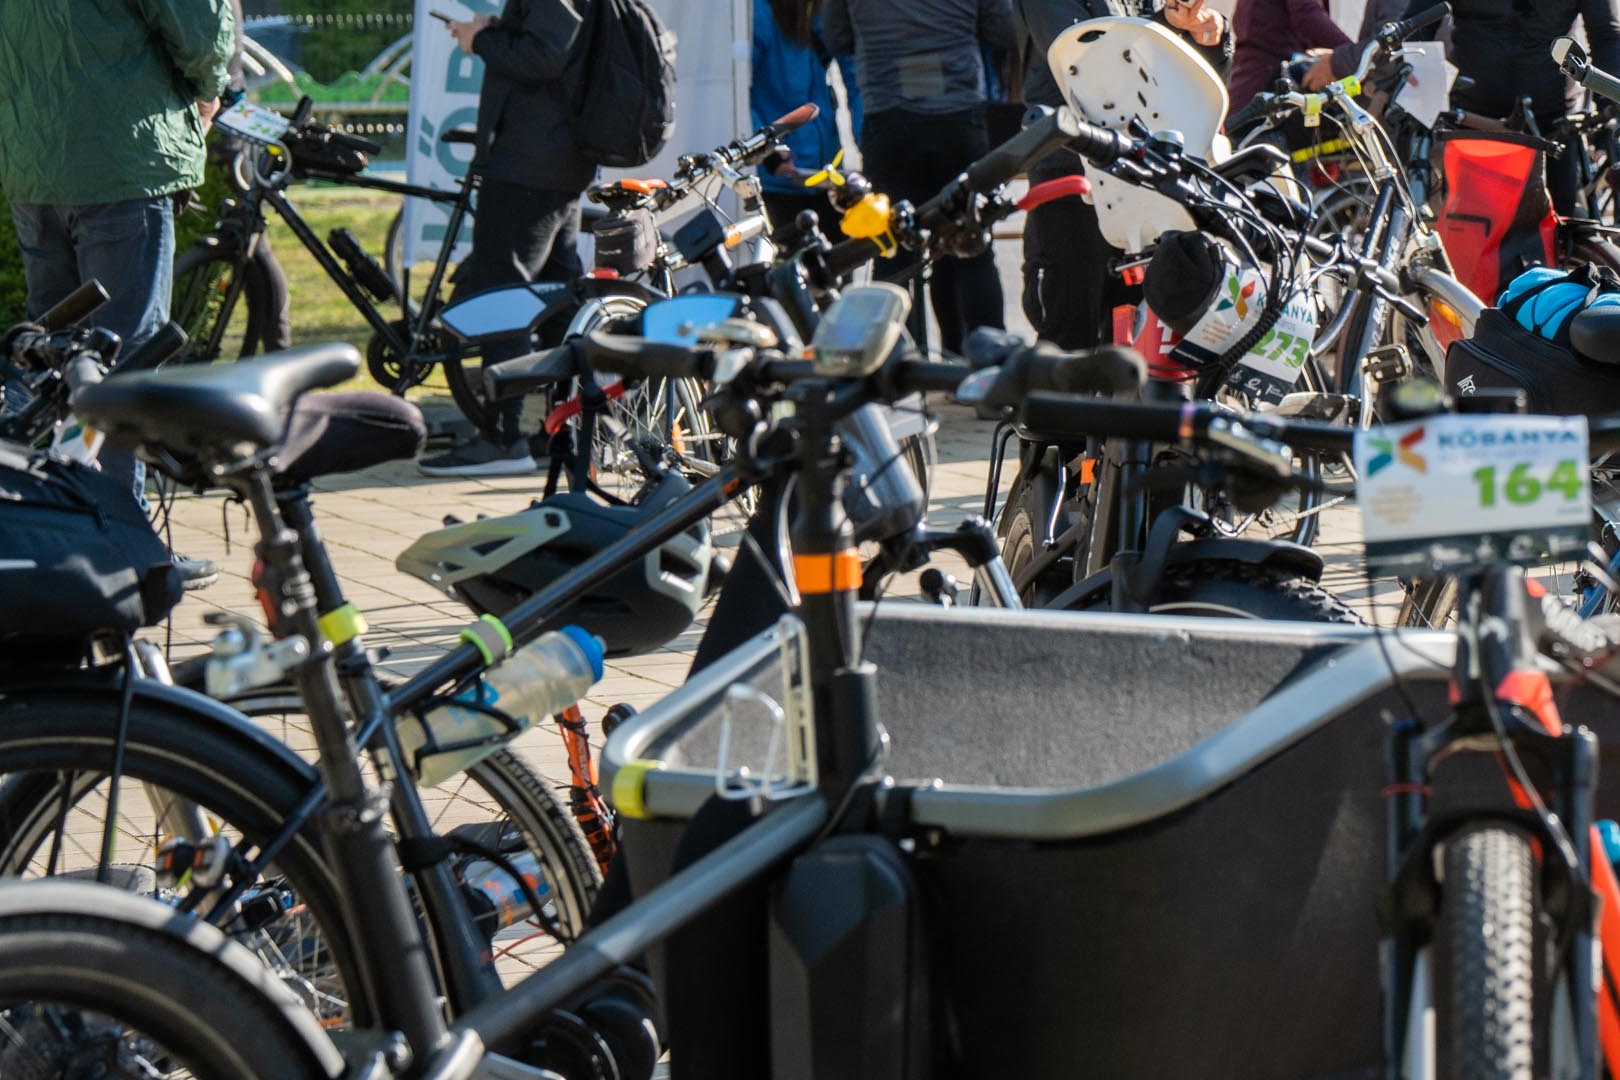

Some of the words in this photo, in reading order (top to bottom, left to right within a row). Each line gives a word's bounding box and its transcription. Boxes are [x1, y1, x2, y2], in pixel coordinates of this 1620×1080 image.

[1251, 328, 1310, 369] 273
[1438, 428, 1578, 448] KŐBÁNYA
[1473, 458, 1584, 508] 164
